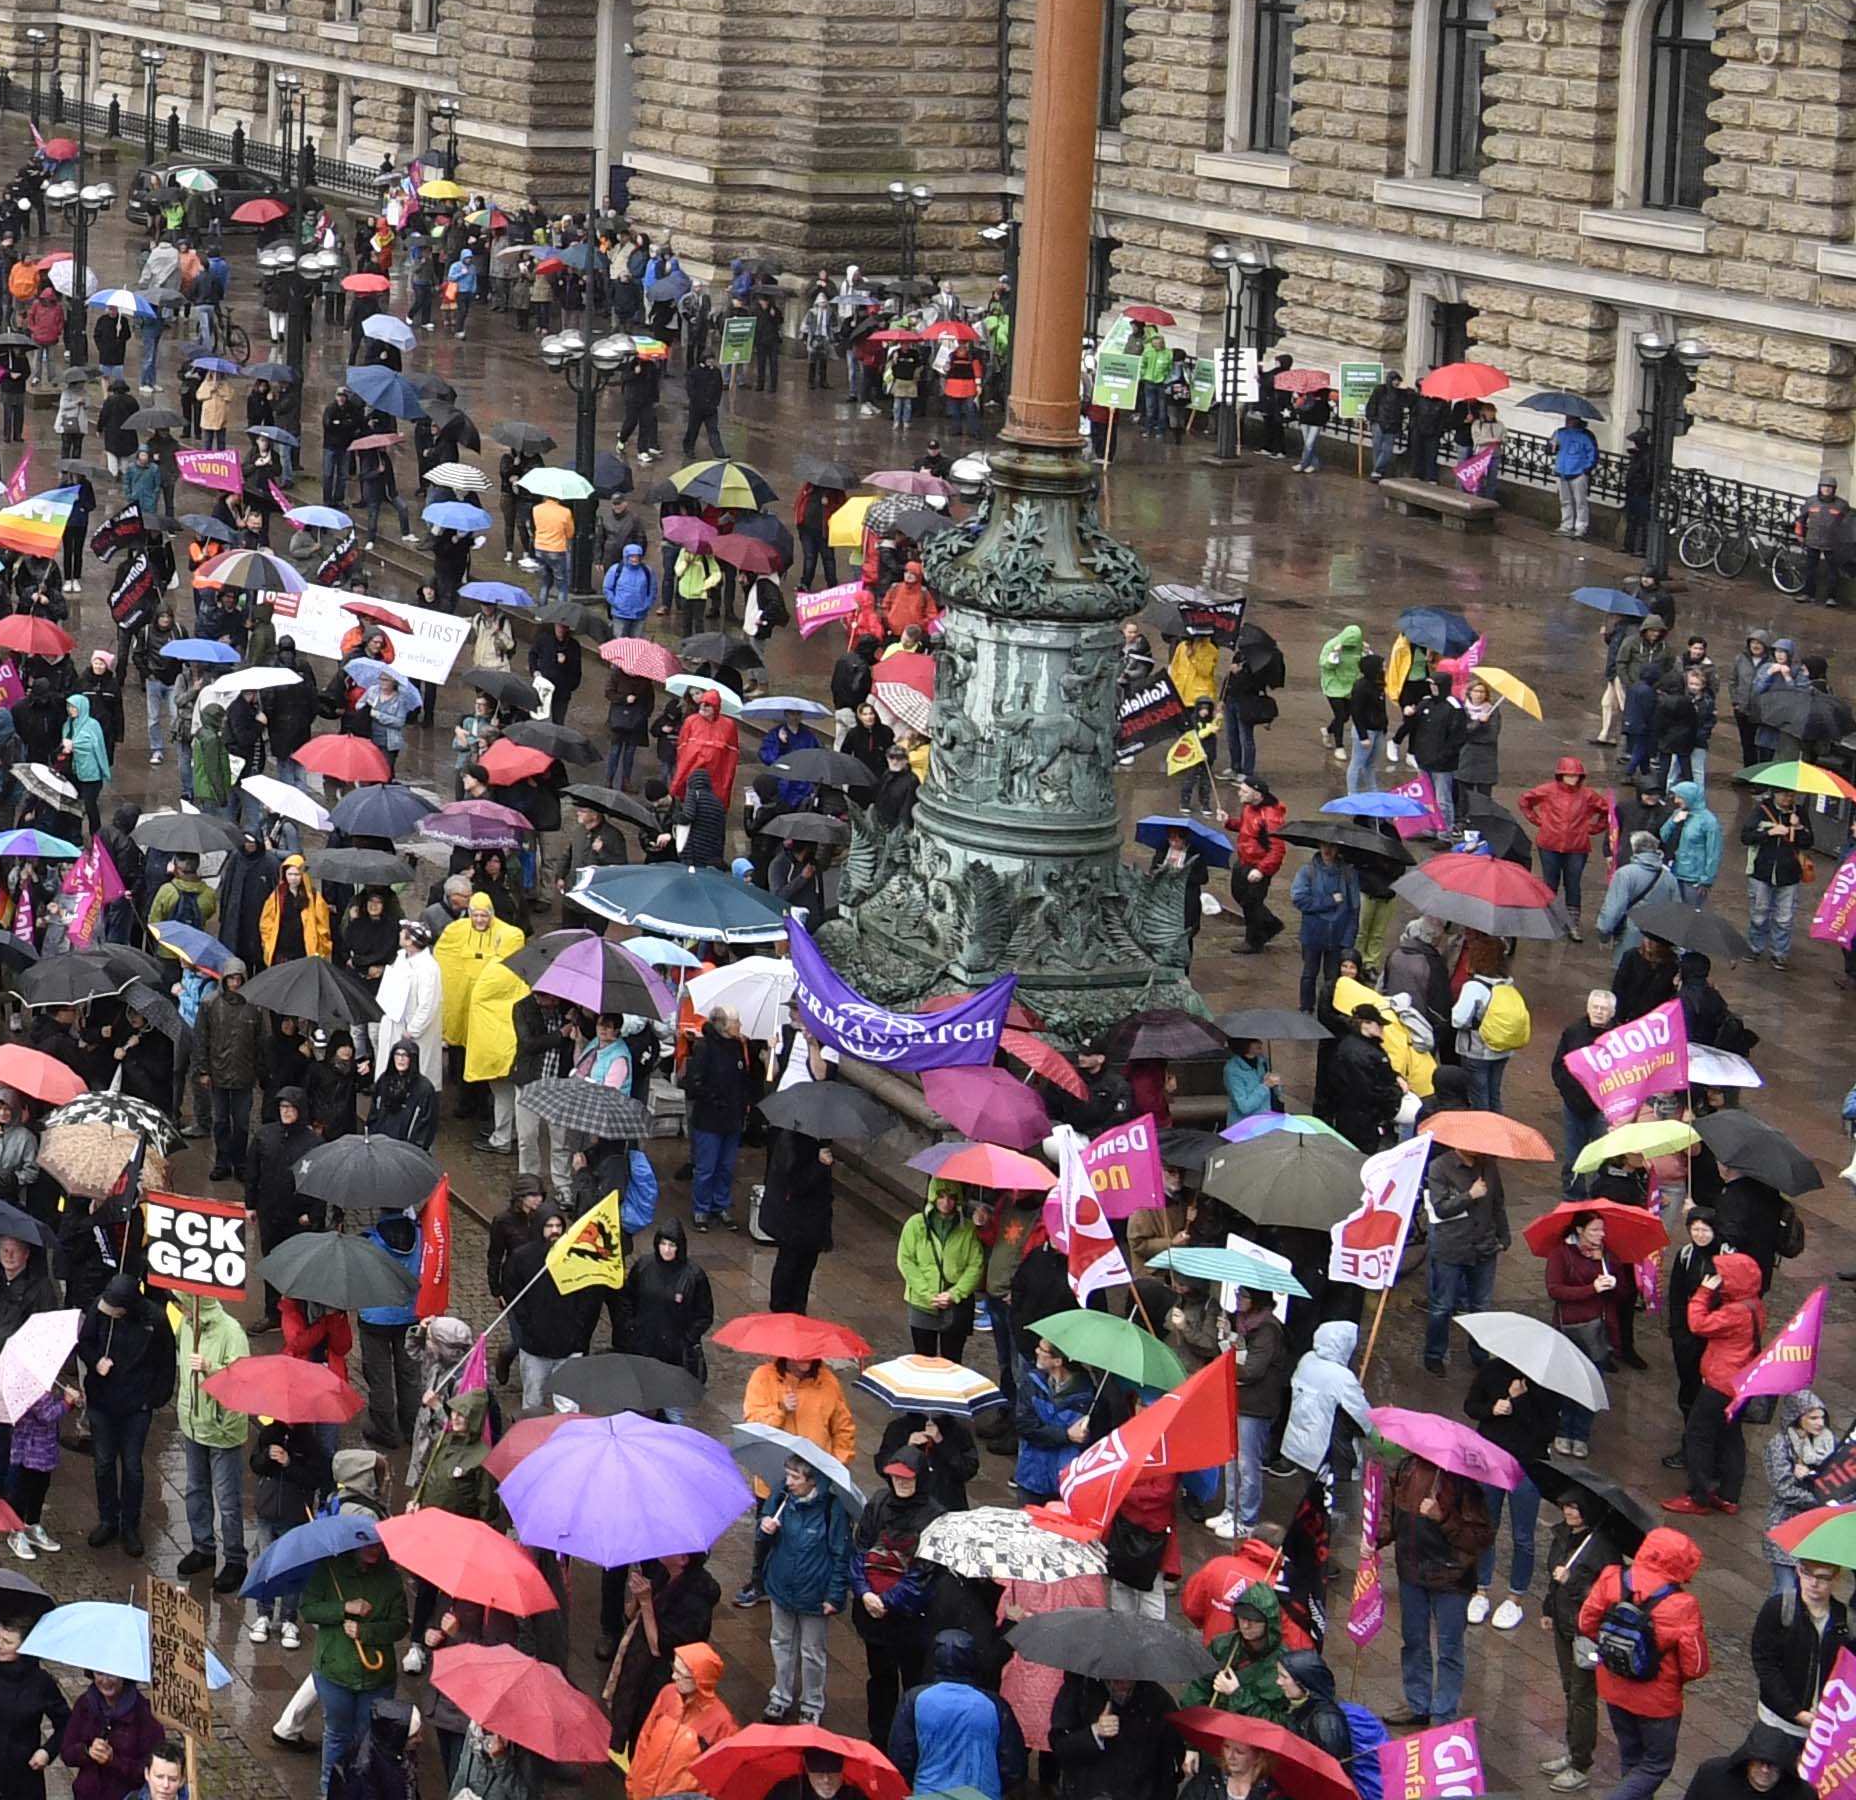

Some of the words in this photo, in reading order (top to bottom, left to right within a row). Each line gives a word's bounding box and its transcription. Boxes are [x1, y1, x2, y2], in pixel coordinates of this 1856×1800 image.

[419, 622, 462, 643] FIRST
[148, 1202, 246, 1253] FCK
[148, 1240, 246, 1286] G20
